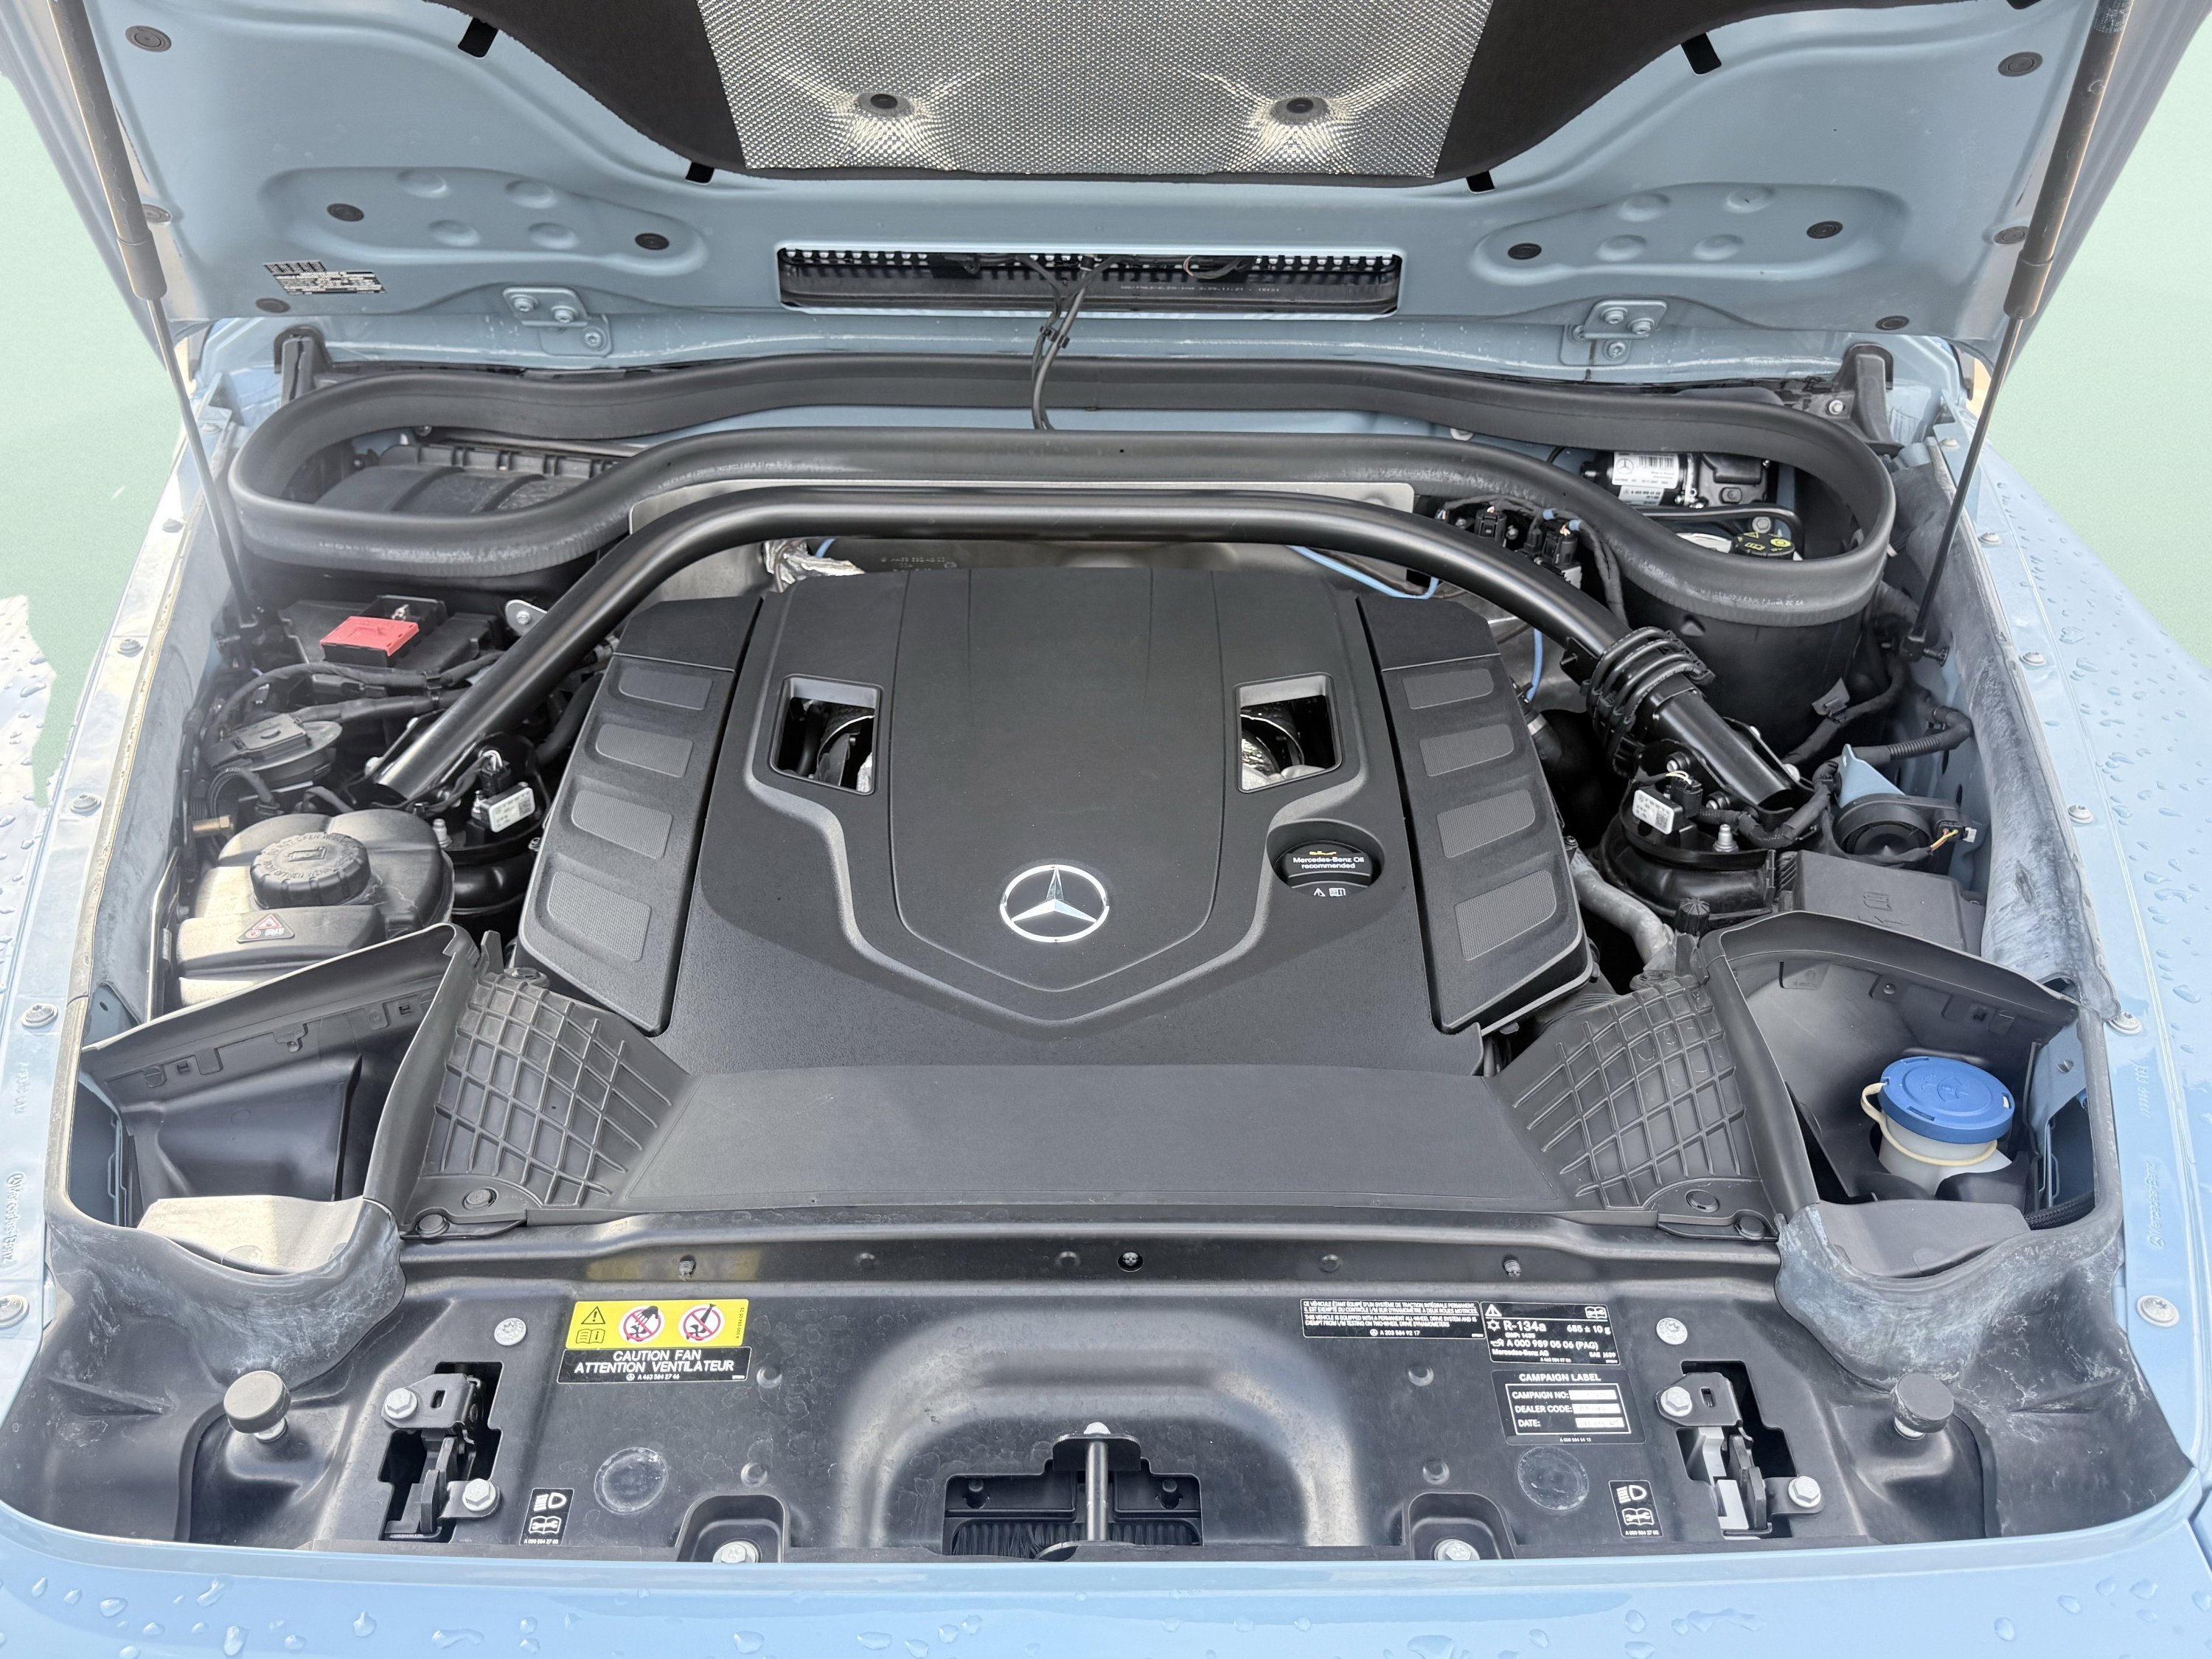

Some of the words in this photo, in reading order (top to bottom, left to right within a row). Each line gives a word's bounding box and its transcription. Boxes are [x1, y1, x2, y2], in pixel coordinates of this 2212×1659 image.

[2145, 1161, 2162, 1236] Mercedes-Benz
[3, 1182, 21, 1262] Mercedes-Benz
[1503, 1320, 1547, 1332] R-134a
[1593, 1325, 1603, 1333] 10
[1506, 1339, 1514, 1347] A
[1514, 1339, 1531, 1347] 000
[1532, 1339, 1548, 1348] 989
[1550, 1340, 1562, 1349] 05
[1562, 1340, 1574, 1349] 06
[1575, 1340, 1599, 1351] (PAG)
[613, 1350, 670, 1361] CAUTION
[674, 1349, 701, 1360] FAN
[574, 1362, 645, 1374] ATTENTION
[652, 1360, 734, 1372] VENTILATEUR
[1519, 1373, 1569, 1382] CAMPAIGN
[1571, 1373, 1601, 1382] LABEL
[1512, 1391, 1554, 1399] CAMPAIGN
[1554, 1391, 1569, 1399] NO:
[1514, 1405, 1546, 1413] DEALER
[1548, 1405, 1573, 1413] CODE:
[1517, 1419, 1541, 1427] DATE:
